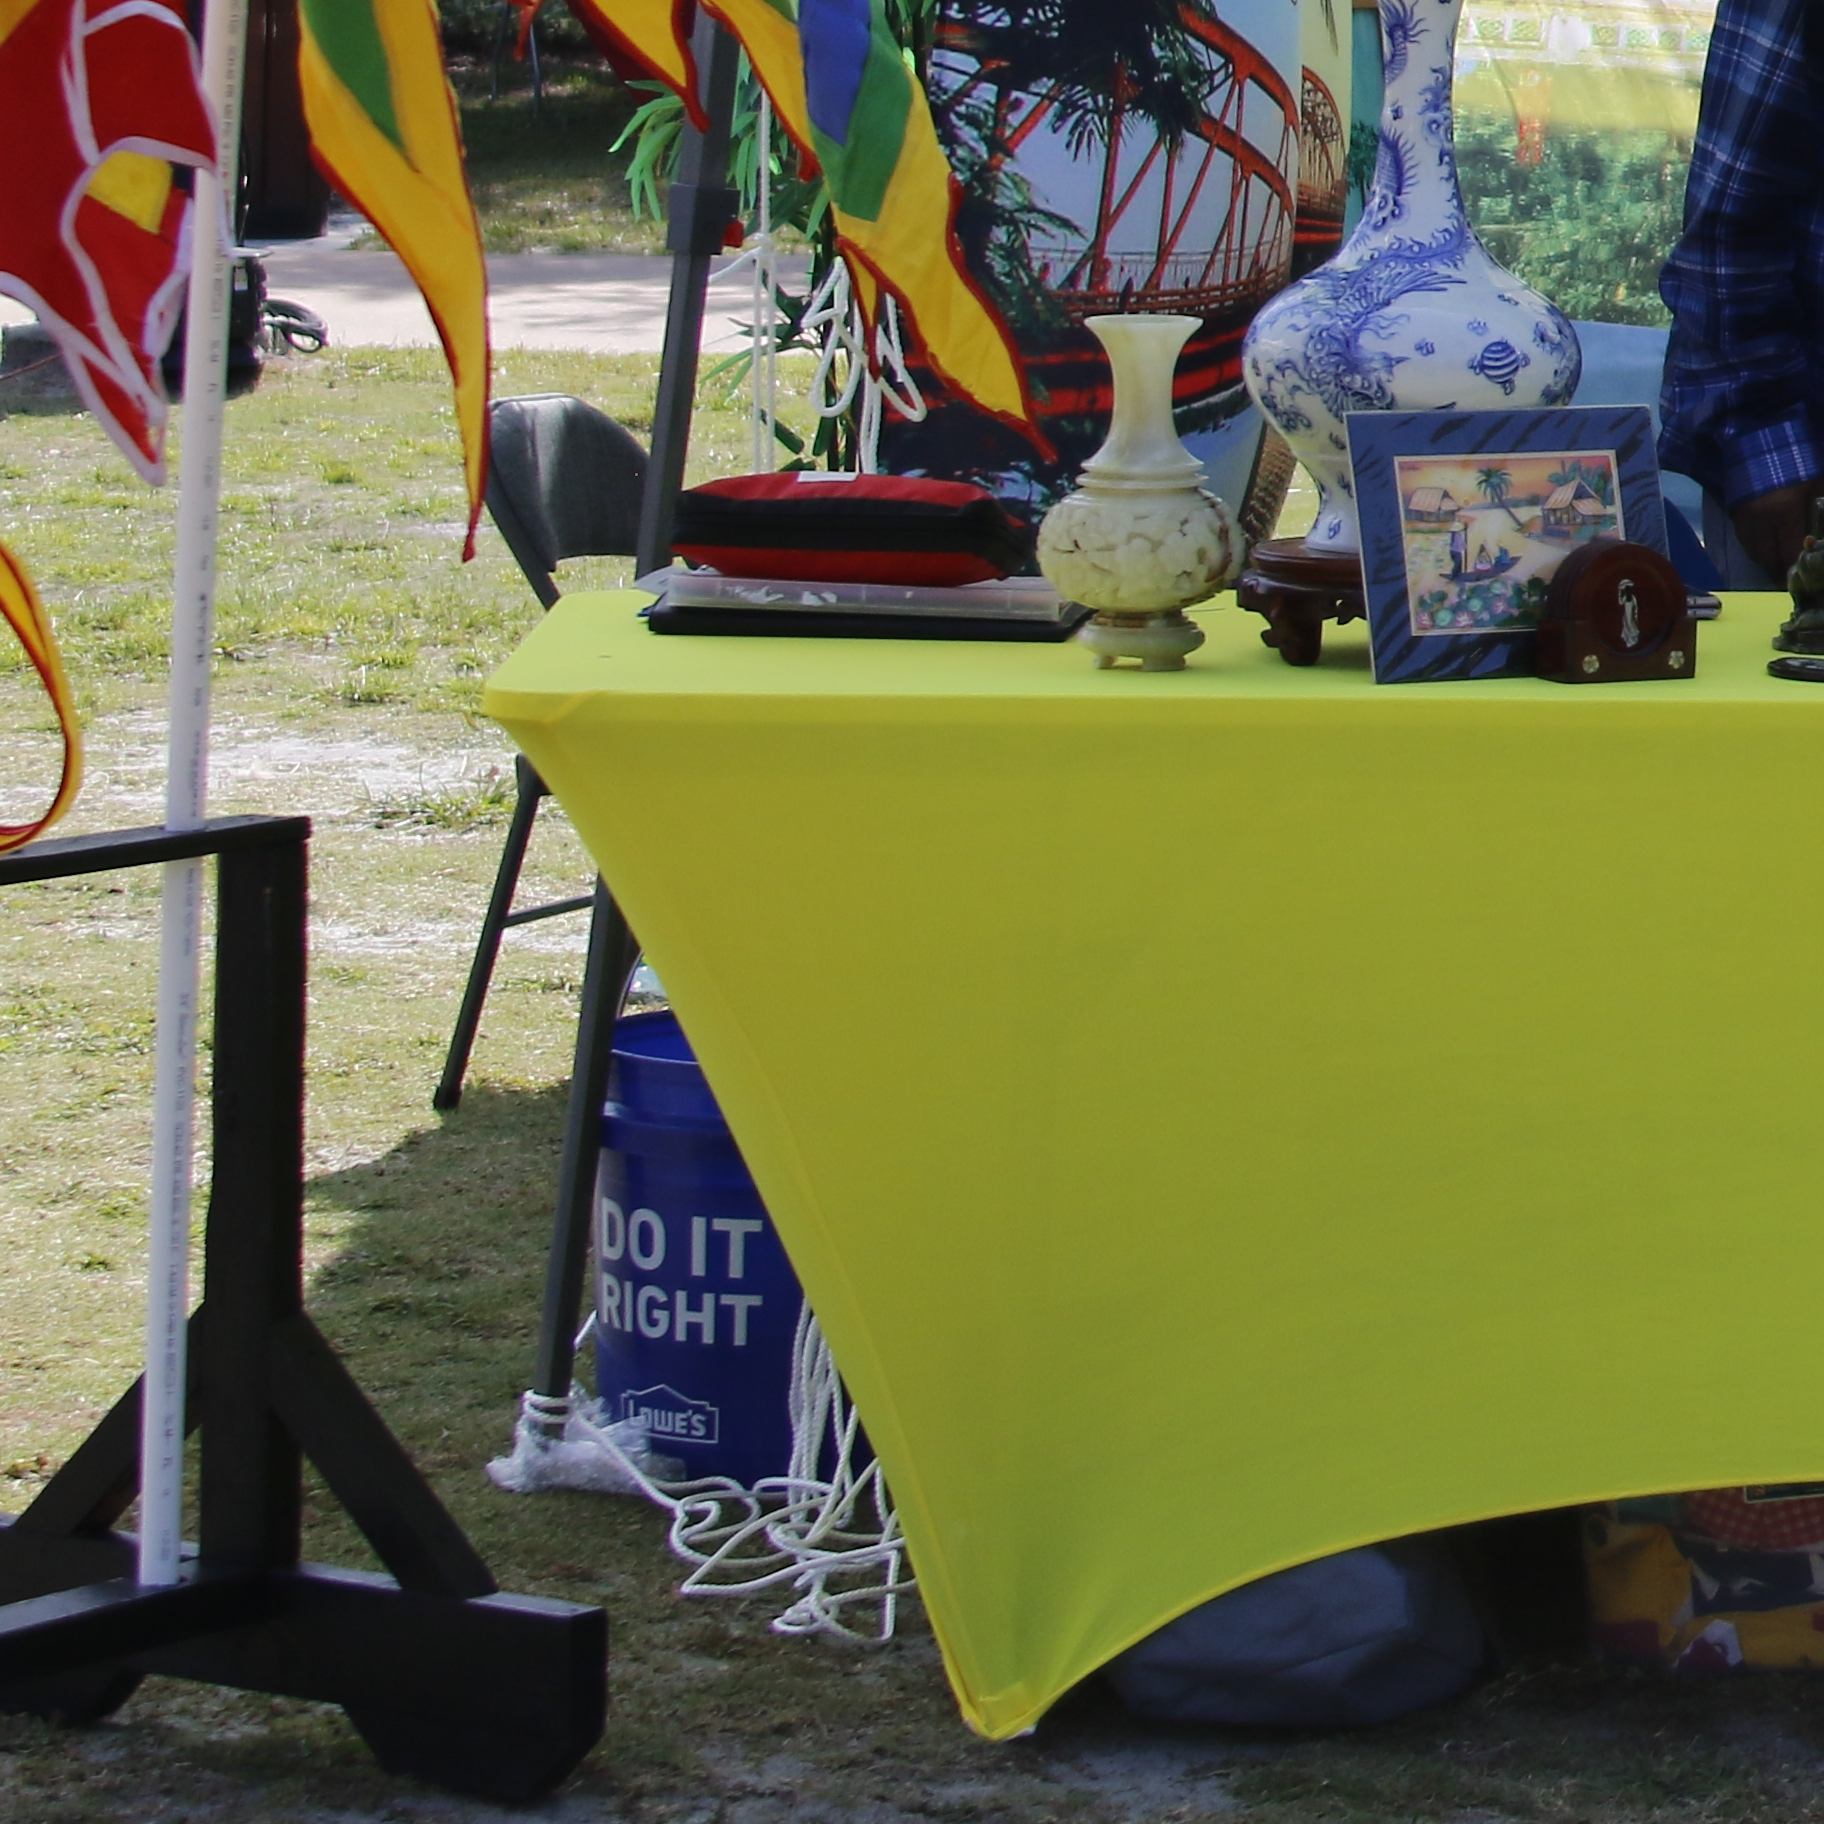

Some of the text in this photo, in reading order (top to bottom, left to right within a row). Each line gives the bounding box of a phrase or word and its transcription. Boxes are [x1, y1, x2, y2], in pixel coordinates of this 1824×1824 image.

[602, 1197, 763, 1279] DO IT
[602, 1271, 764, 1347] RIGHT
